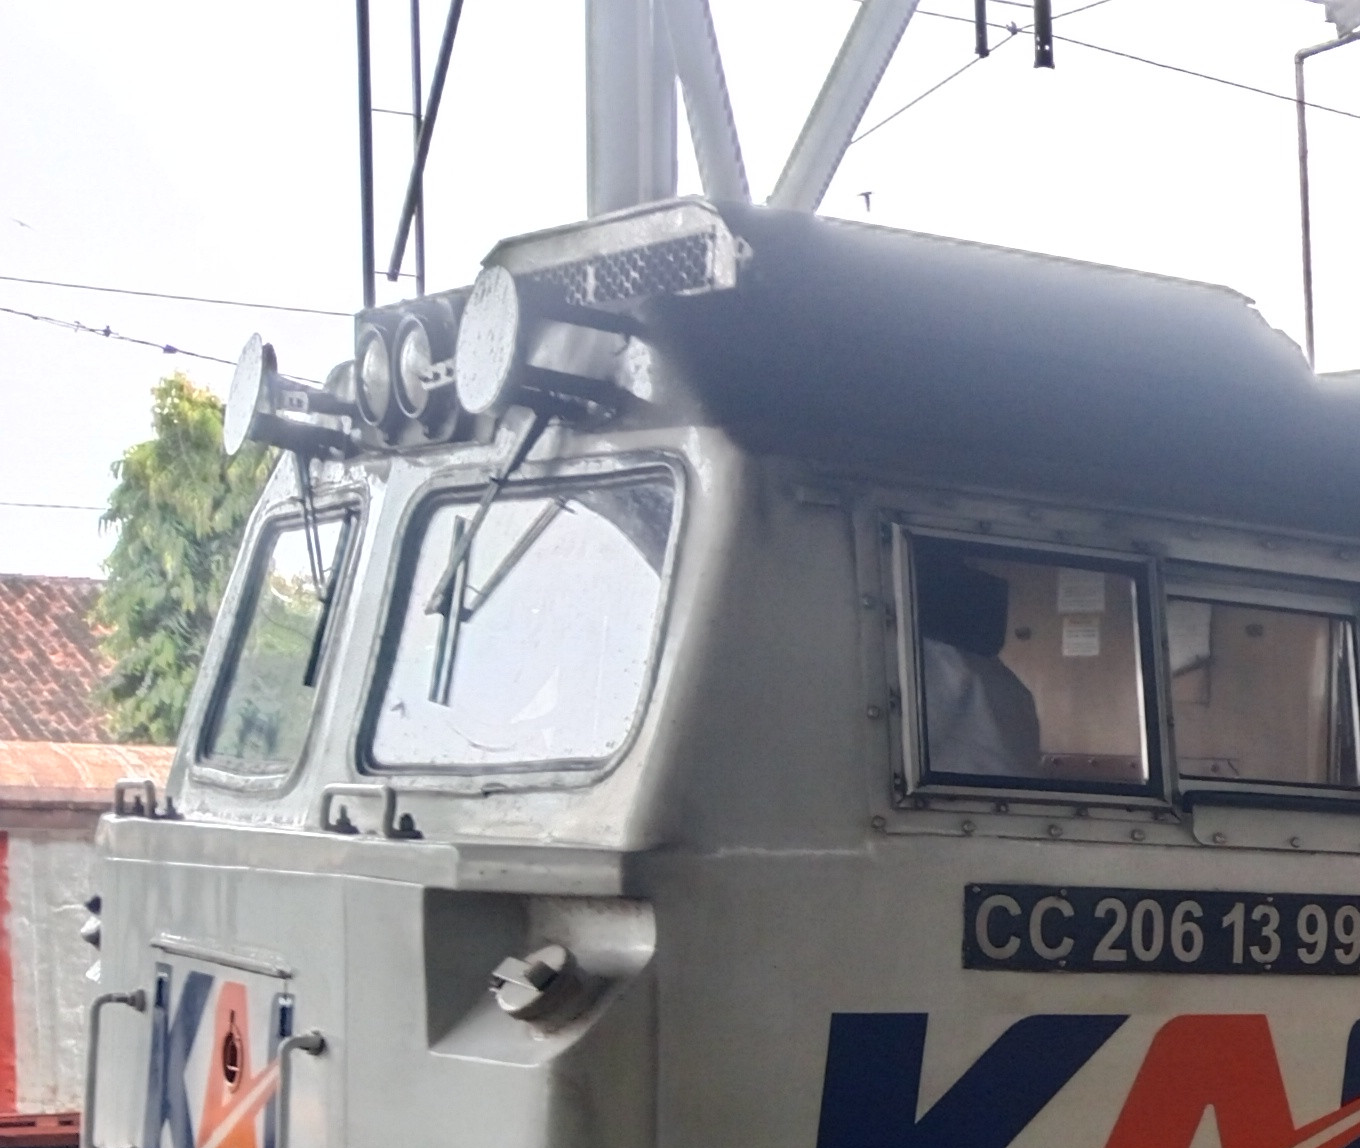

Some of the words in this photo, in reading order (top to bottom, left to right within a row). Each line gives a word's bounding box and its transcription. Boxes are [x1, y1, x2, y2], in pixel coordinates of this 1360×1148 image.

[974, 894, 1075, 961] CC
[1094, 898, 1203, 964] 206
[1221, 902, 1282, 965] 13
